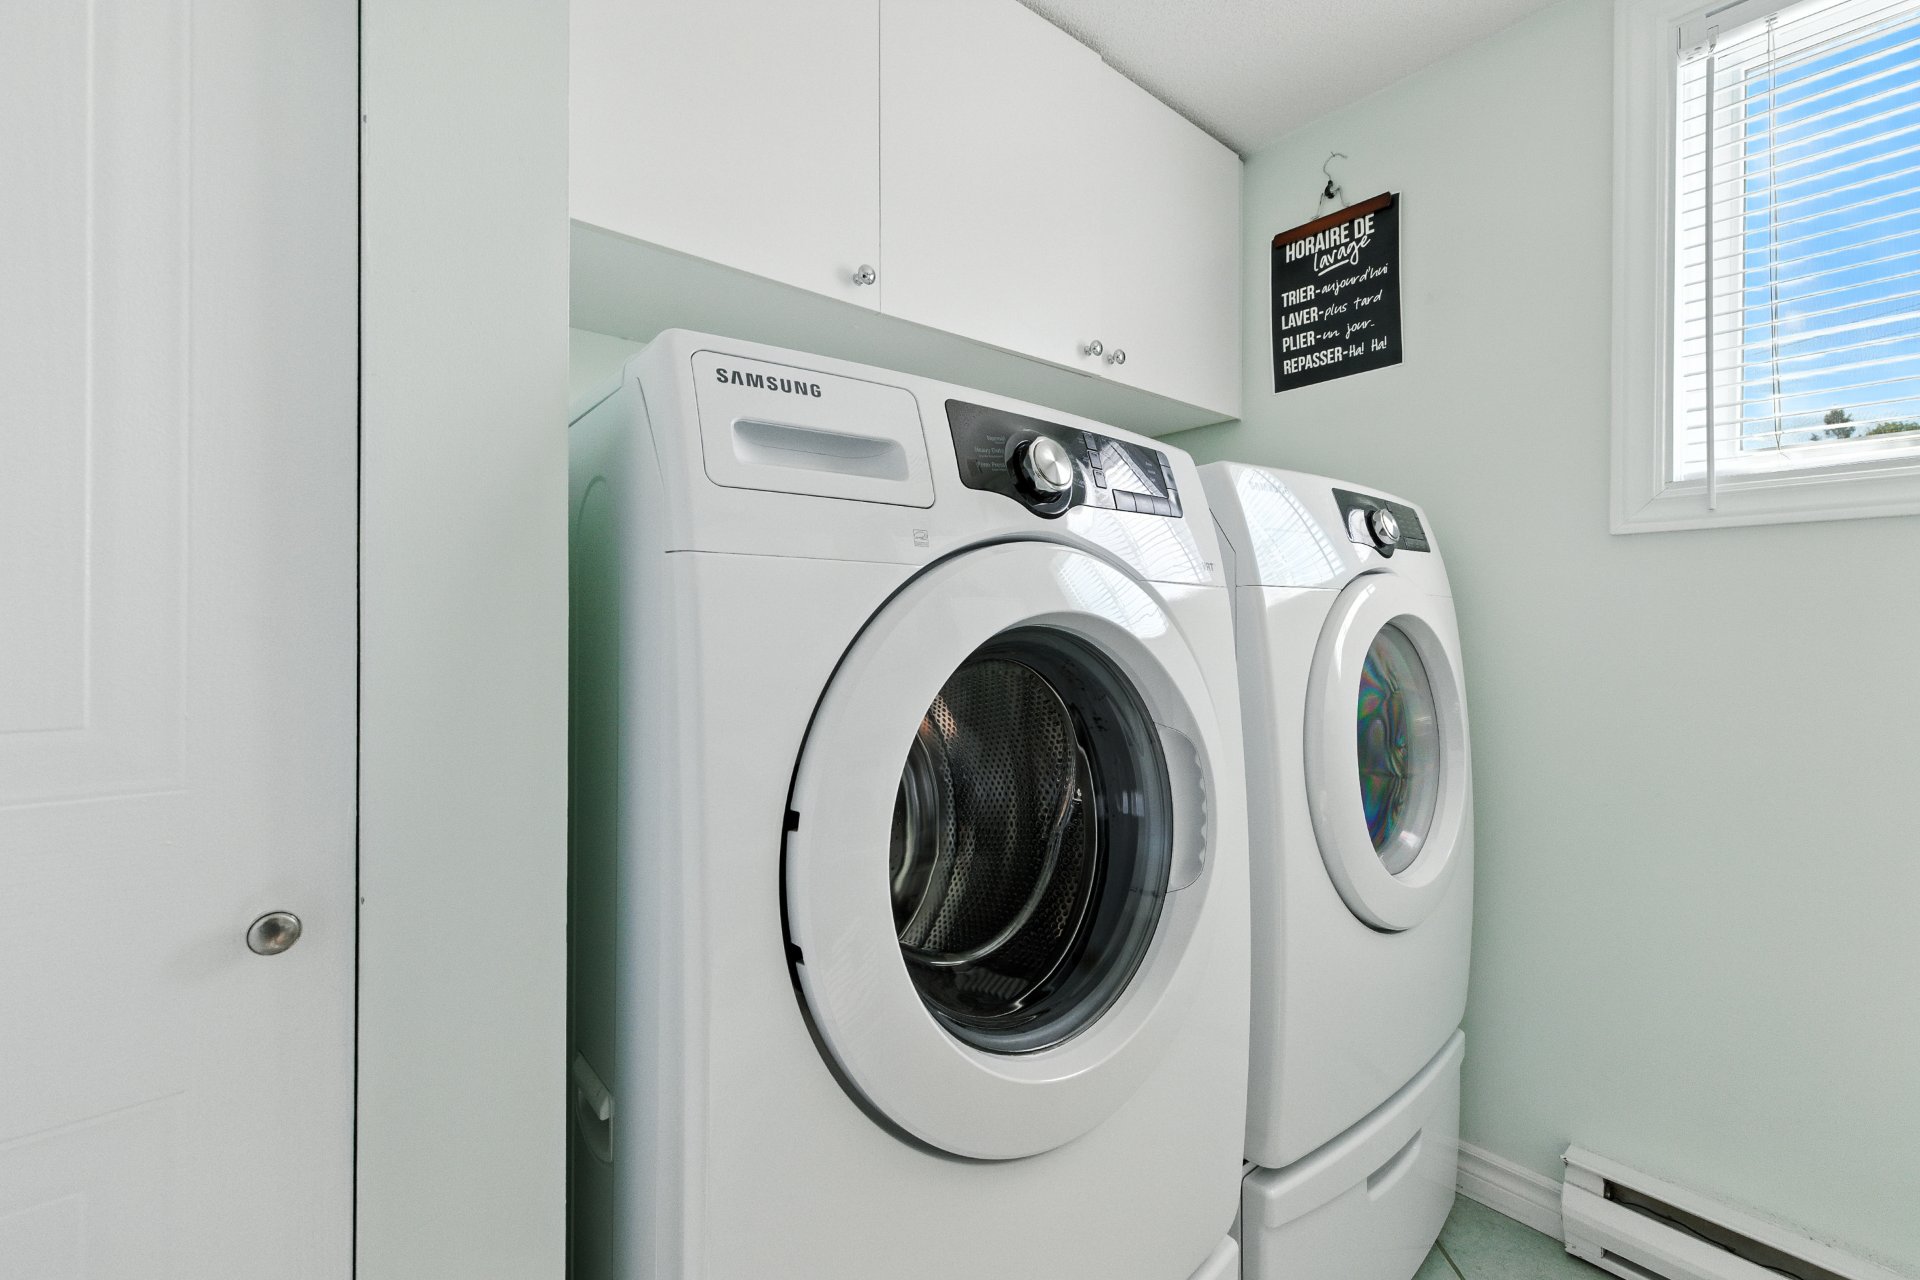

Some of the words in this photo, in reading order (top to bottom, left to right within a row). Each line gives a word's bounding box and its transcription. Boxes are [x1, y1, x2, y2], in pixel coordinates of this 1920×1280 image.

[1285, 223, 1350, 263] HORAIRE
[1353, 213, 1375, 239] DE
[1313, 235, 1371, 272] lavage
[1353, 289, 1383, 311] tard
[1371, 335, 1388, 352] Ha!
[716, 368, 822, 398] SAMSUNG
